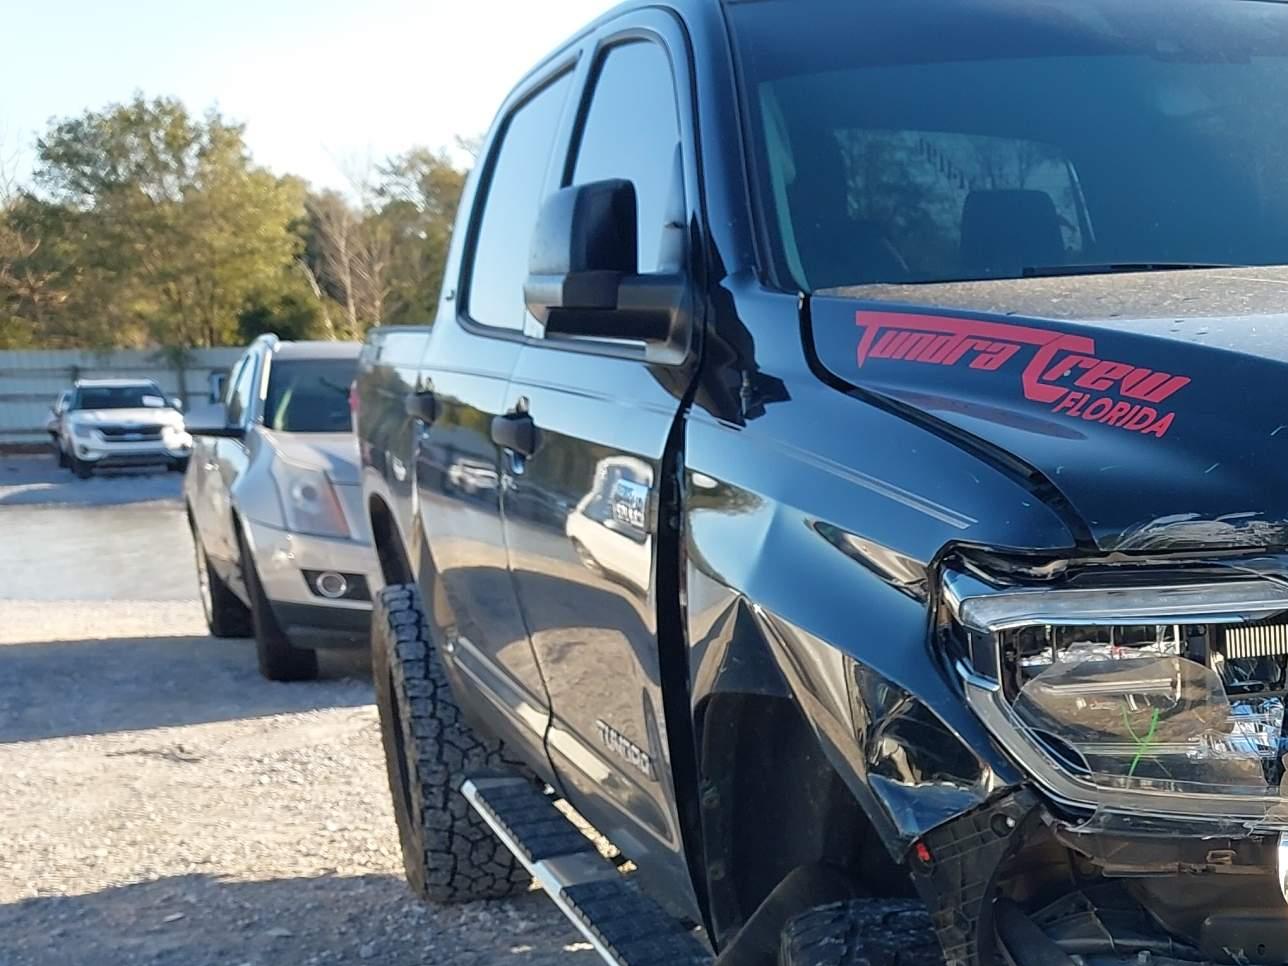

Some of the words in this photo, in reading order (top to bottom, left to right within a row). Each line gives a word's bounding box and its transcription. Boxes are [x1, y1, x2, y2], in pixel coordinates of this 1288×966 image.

[855, 310, 1030, 371] Tundra
[1021, 333, 1192, 404] Crew
[1050, 391, 1176, 439] FLORIDA
